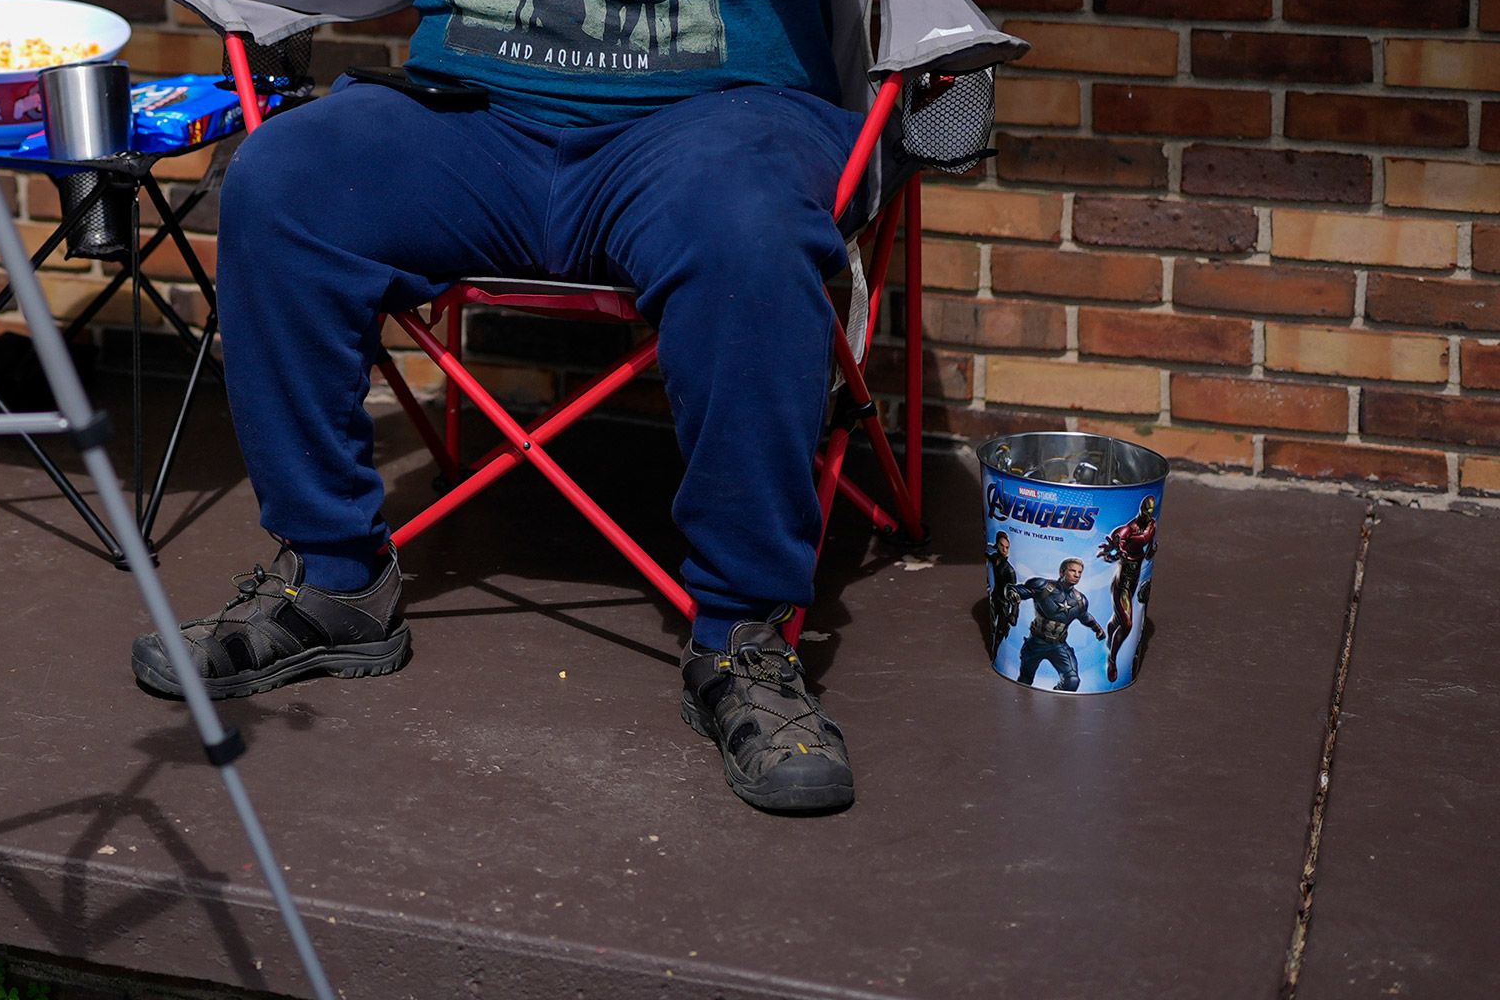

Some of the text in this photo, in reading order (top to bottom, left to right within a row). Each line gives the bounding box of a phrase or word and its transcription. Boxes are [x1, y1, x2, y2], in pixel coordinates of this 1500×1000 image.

[498, 40, 649, 70] AND AQUARIUM
[987, 480, 1100, 531] AVENGERS
[1008, 526, 1022, 535] ONLY
[1031, 532, 1064, 542] THEATERS
